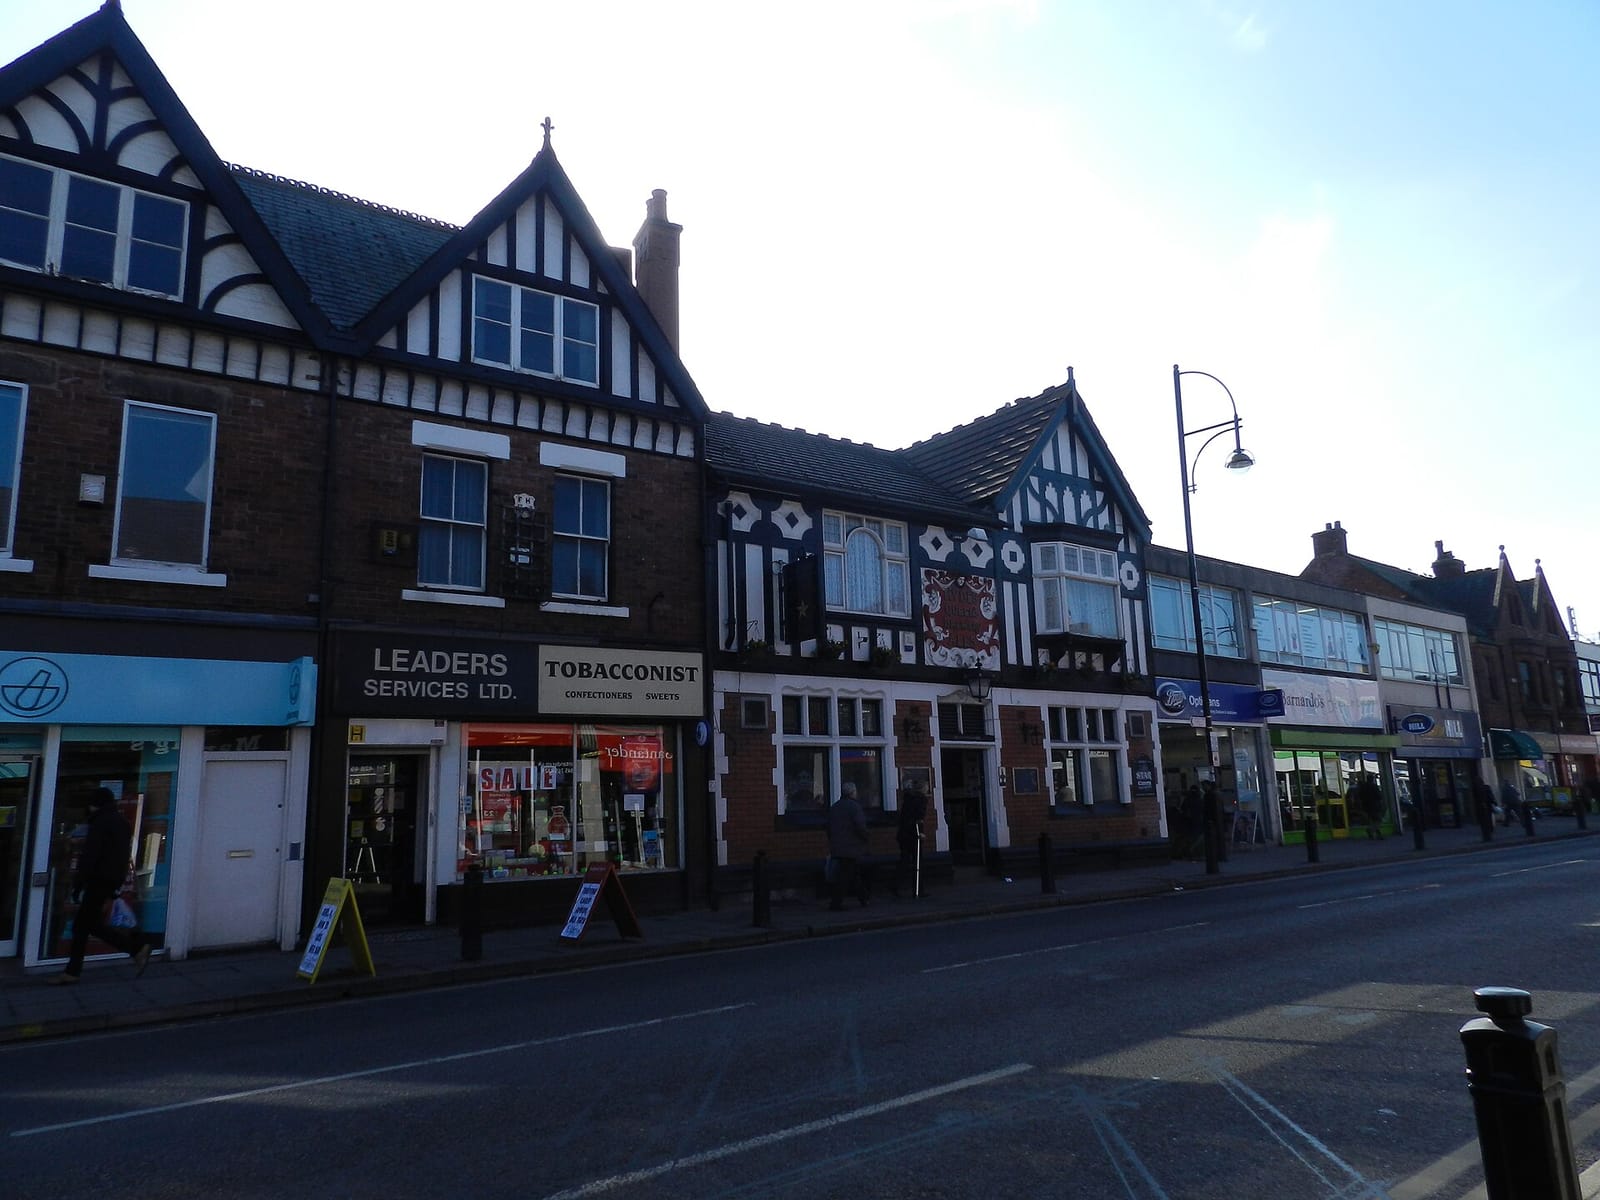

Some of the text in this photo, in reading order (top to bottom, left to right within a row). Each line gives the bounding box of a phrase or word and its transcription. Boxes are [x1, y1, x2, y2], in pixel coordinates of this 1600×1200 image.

[374, 647, 508, 676] LEADERS
[545, 660, 698, 682] TOBACCONIST
[363, 678, 517, 699] SERVICES LTD.
[565, 690, 680, 701] CONFECTIONERS SWEETS
[1188, 695, 1221, 708] Optians
[480, 767, 555, 790] SALE
